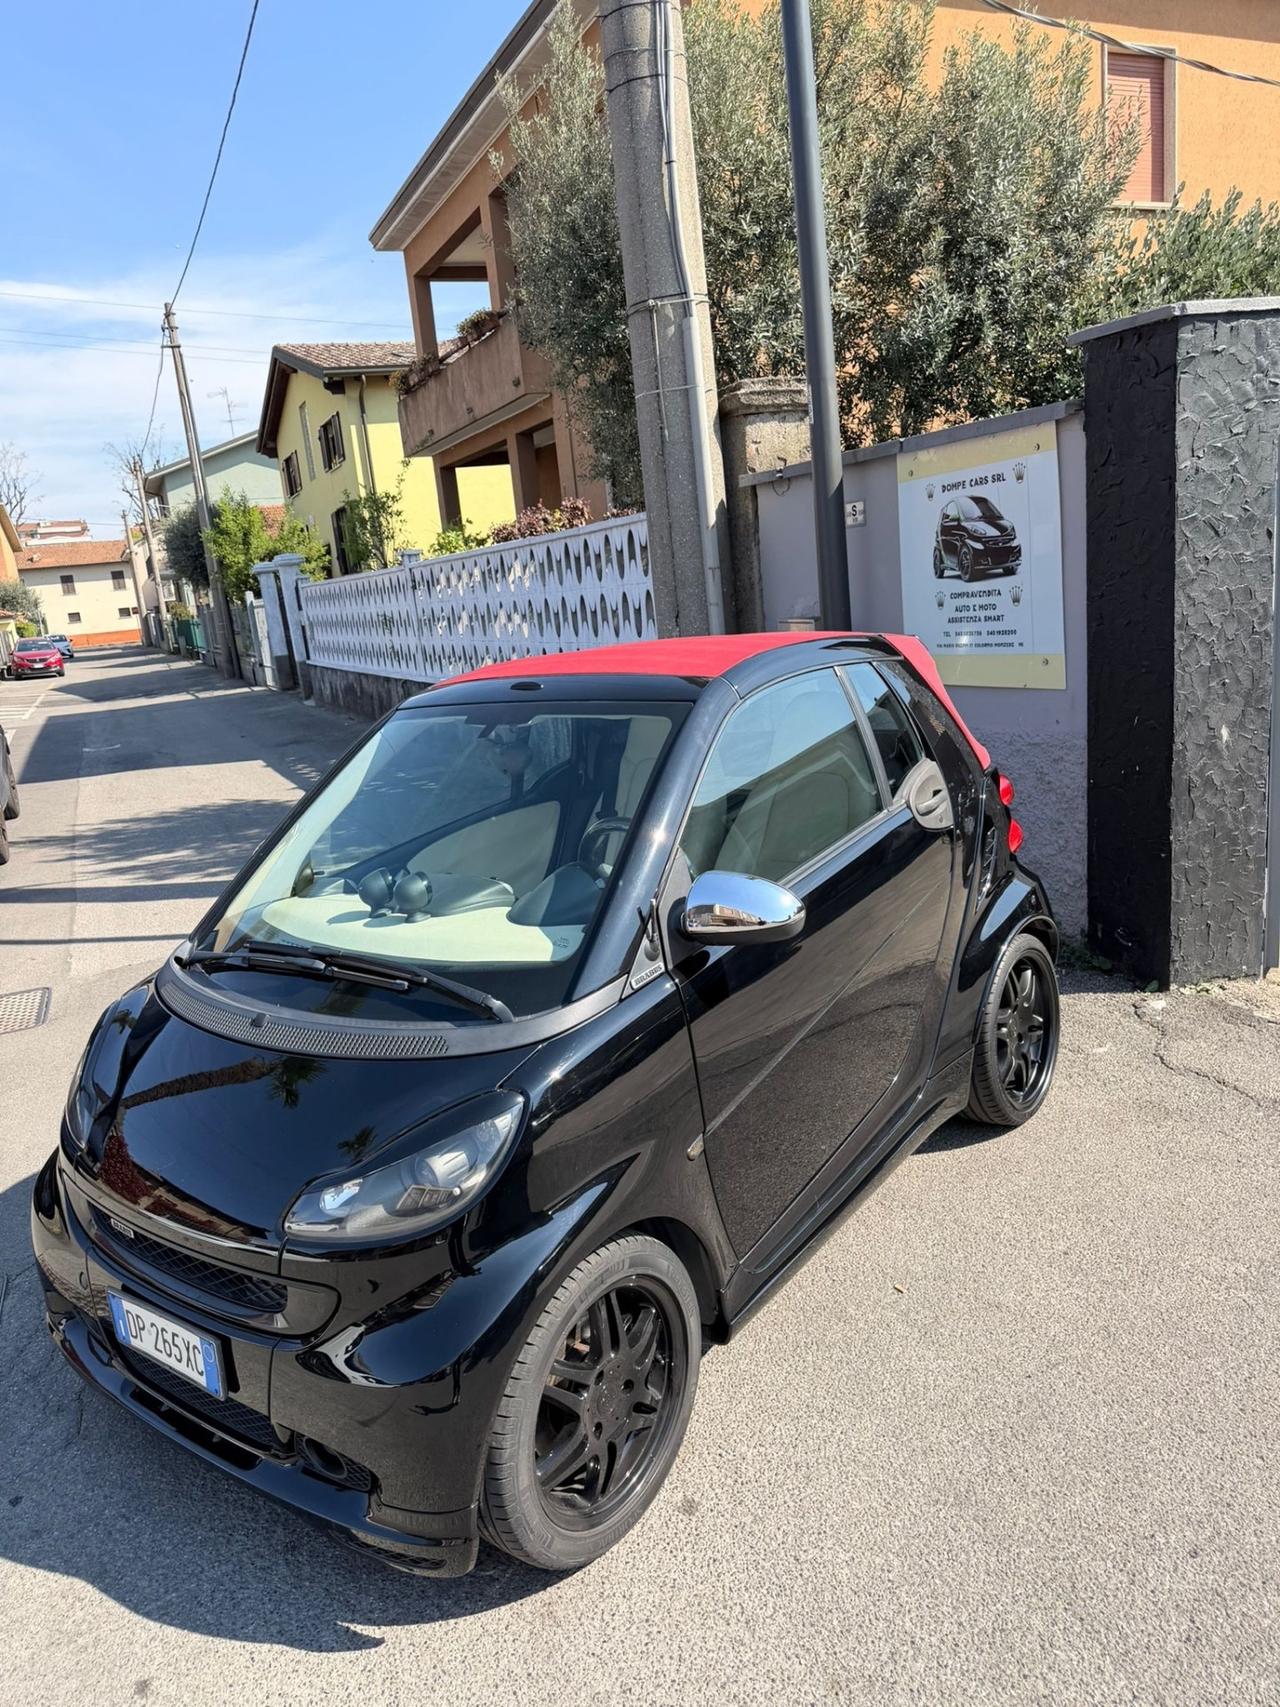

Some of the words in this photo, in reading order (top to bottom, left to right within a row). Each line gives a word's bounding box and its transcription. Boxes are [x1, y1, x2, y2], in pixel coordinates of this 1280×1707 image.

[941, 480, 966, 493] DOMPE
[969, 475, 989, 488] CARS
[991, 472, 1007, 484] SRL
[851, 504, 858, 517] S
[949, 589, 1002, 600] COMPRAVENDITA
[954, 604, 971, 613] AUTO
[972, 604, 977, 612] E
[978, 603, 997, 612] MOTO
[947, 615, 982, 624] ASSISTENZA
[983, 614, 1005, 623] SMART
[633, 964, 663, 987] BRABUS
[125, 1308, 147, 1344] DP
[149, 1322, 205, 1377] 265XC
